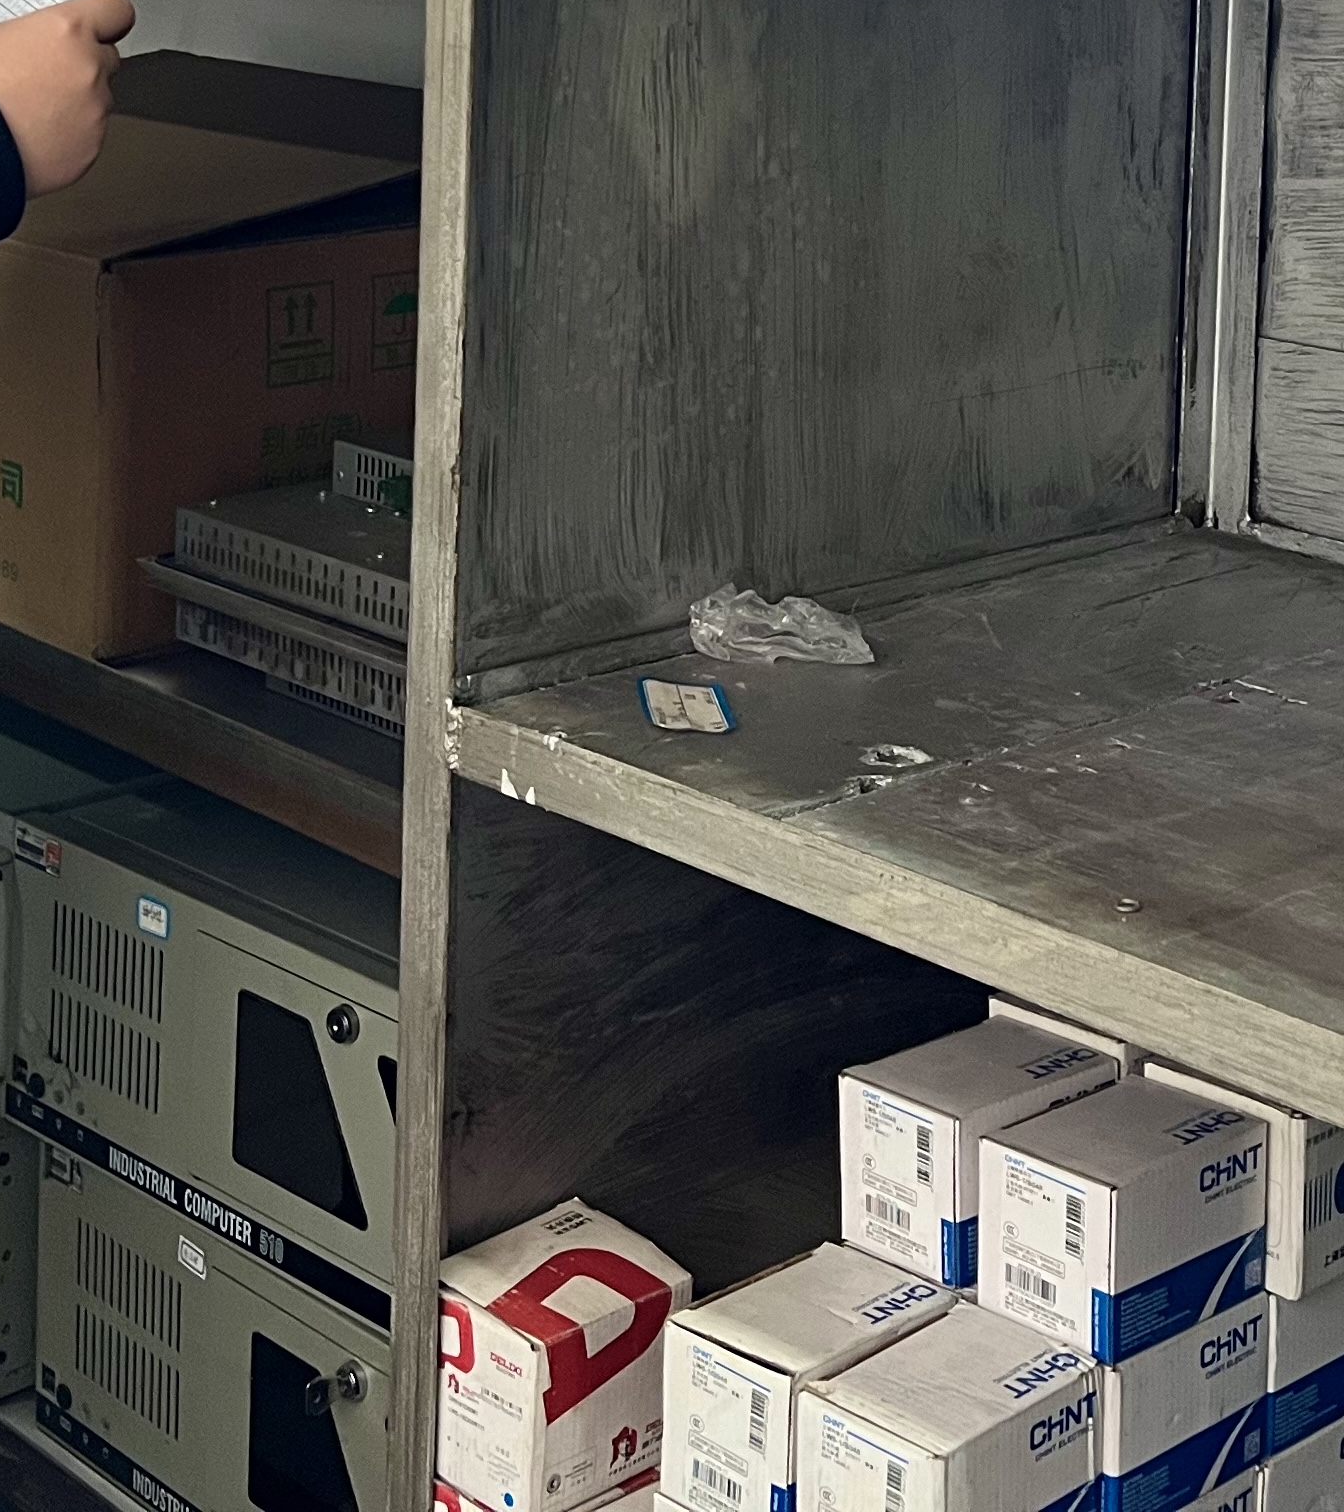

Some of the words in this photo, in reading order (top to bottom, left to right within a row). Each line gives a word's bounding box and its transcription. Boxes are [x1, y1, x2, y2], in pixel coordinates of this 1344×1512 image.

[109, 1146, 177, 1205] INDUSTRIAL
[184, 1188, 252, 1246] COMPUTER
[259, 1229, 284, 1264] 510
